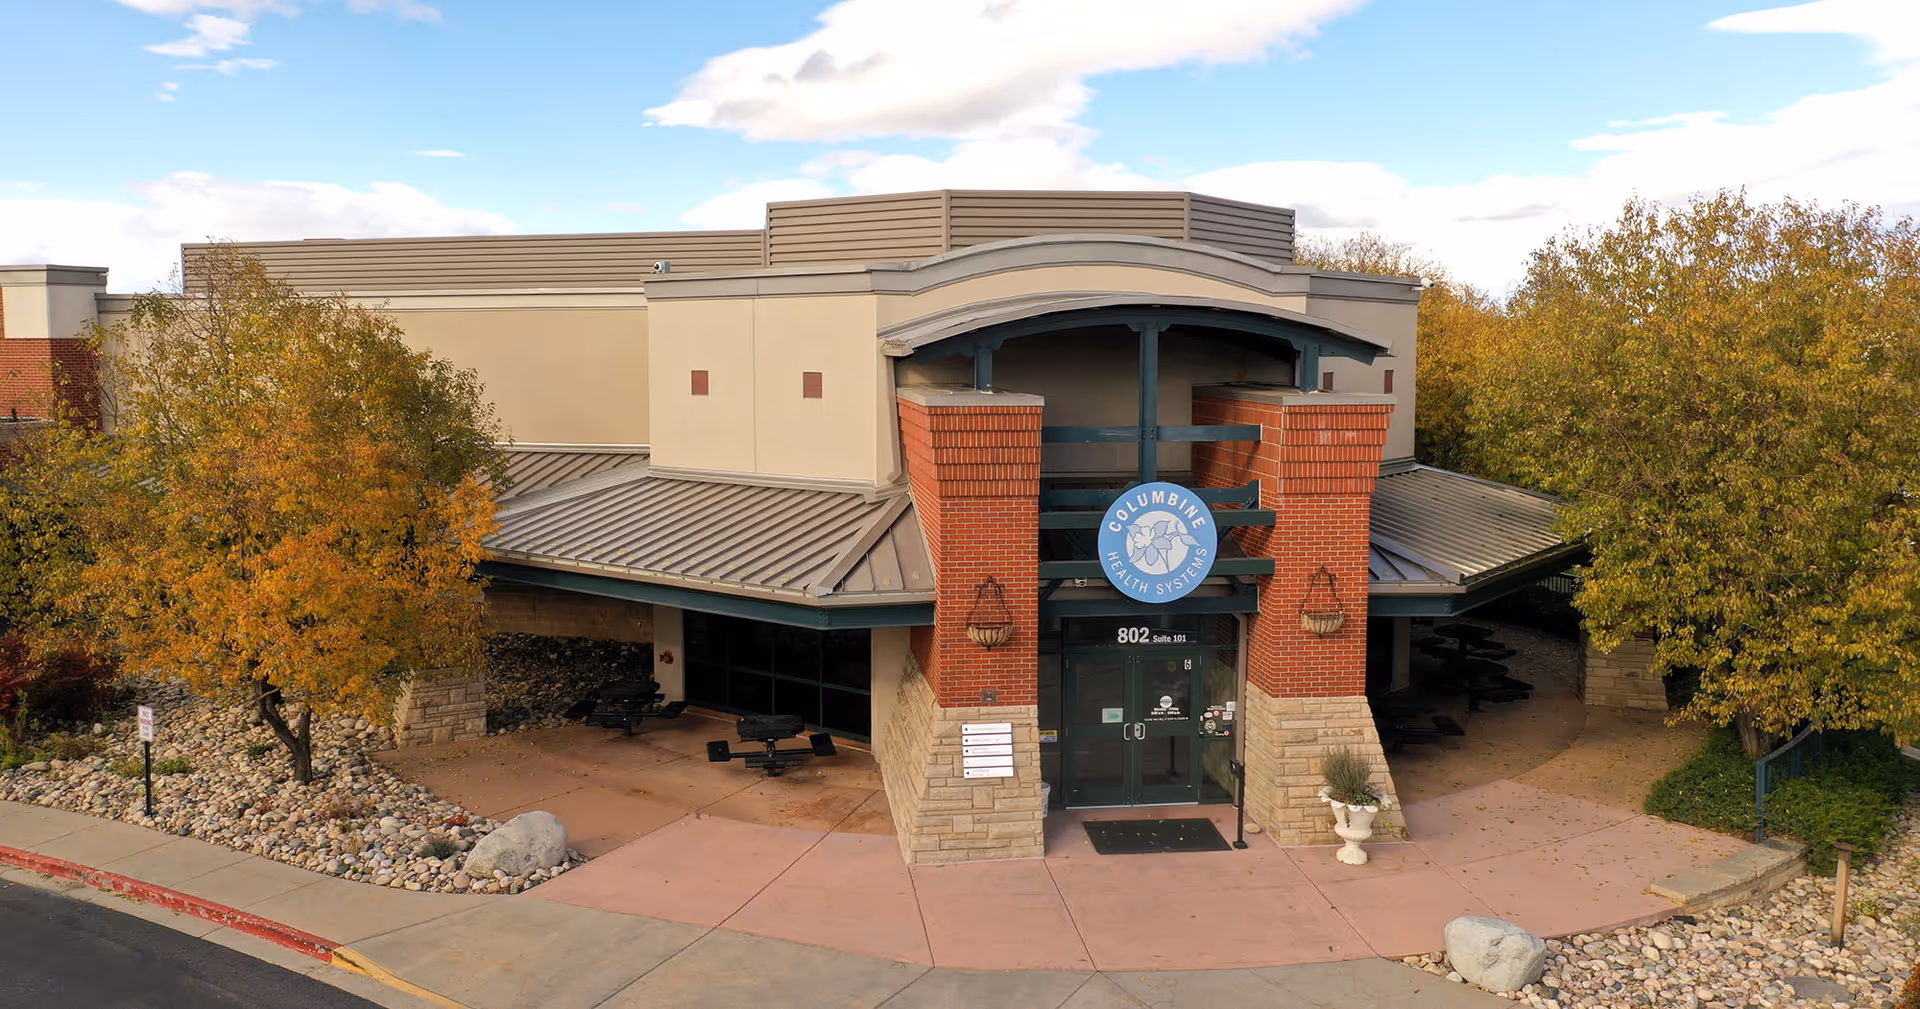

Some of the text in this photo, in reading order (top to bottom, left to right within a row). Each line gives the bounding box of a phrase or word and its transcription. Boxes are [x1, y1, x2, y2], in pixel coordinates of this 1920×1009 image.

[1108, 490, 1206, 533] COLUMBINE
[1107, 547, 1208, 595] HEALTH SYSTEMS
[1117, 626, 1187, 644] 802 Suite 101
